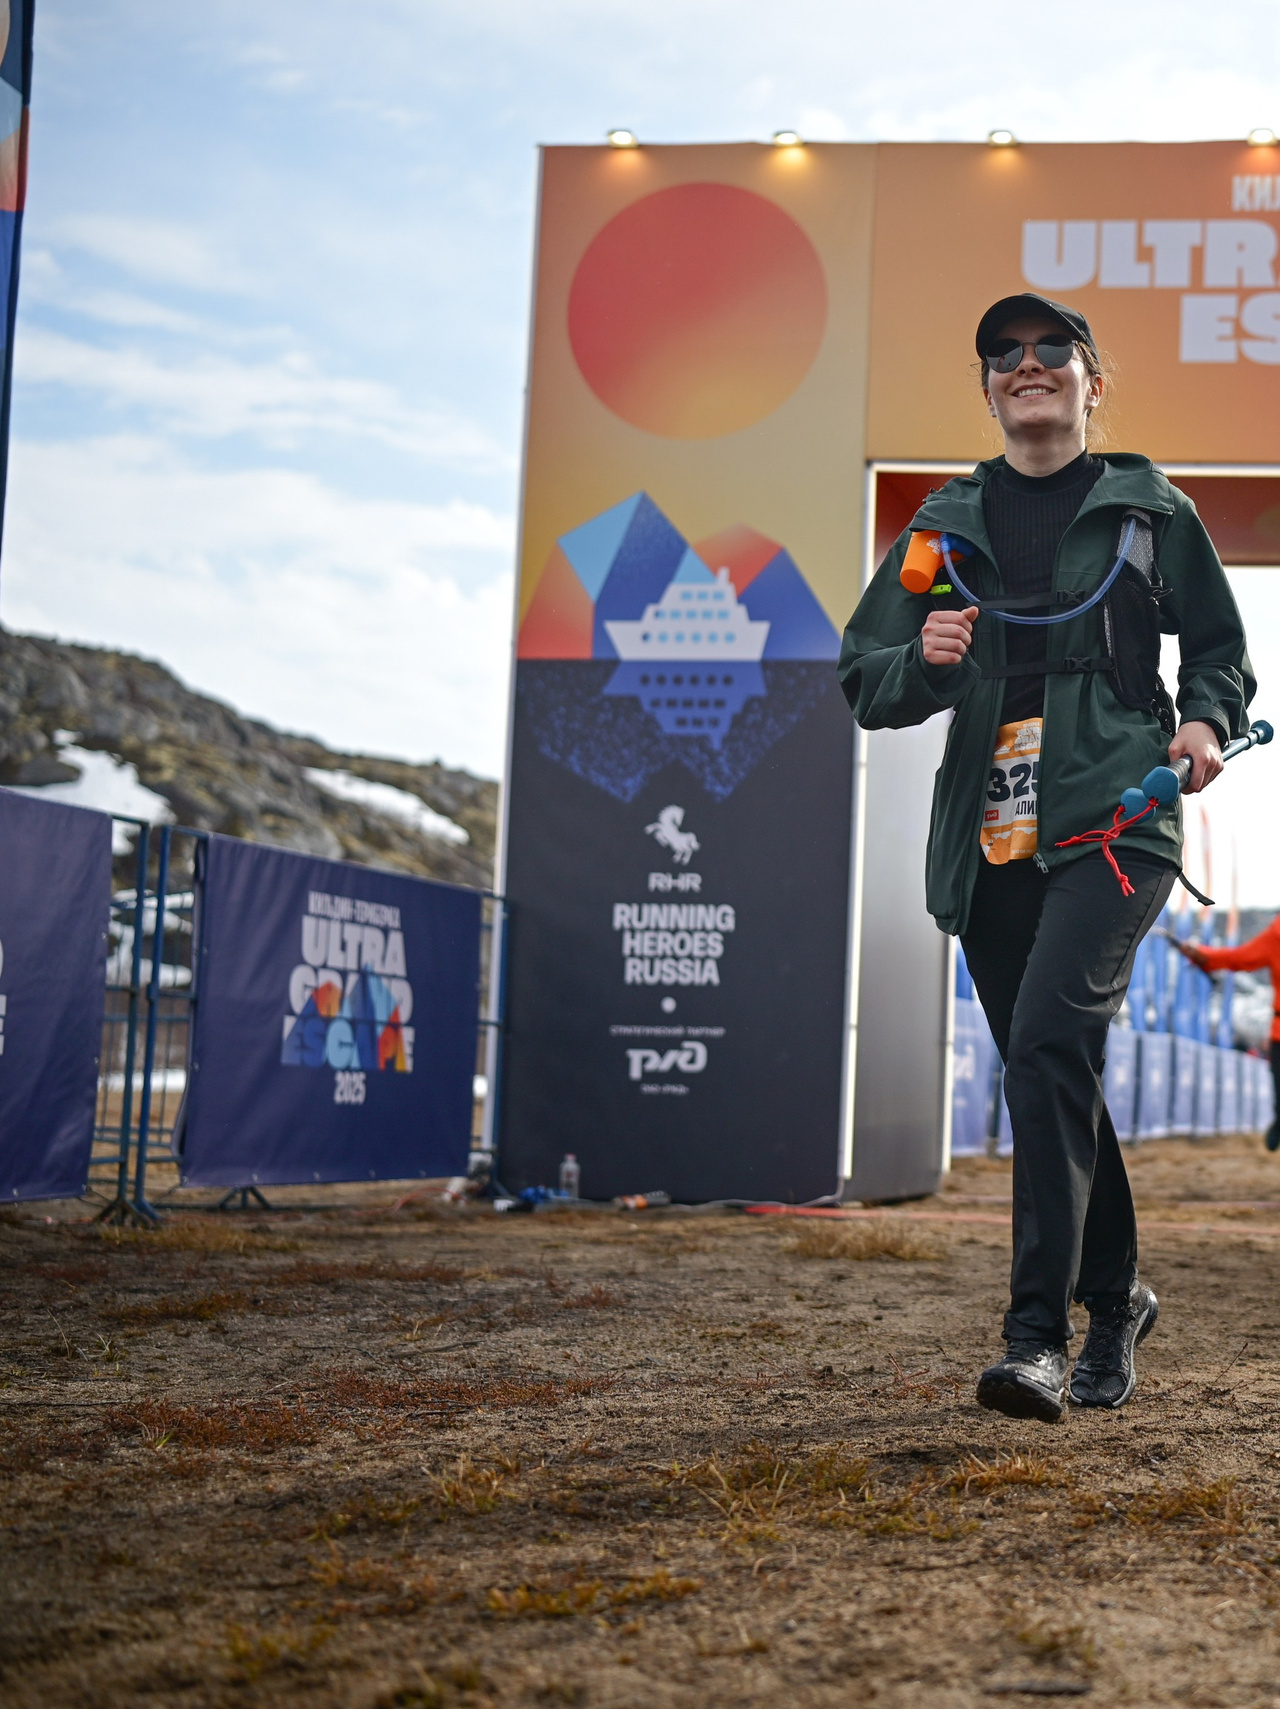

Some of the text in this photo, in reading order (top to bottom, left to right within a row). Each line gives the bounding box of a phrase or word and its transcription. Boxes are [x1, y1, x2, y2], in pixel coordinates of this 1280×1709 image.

[1014, 800, 1038, 816] АЛИ
[648, 872, 702, 892] RHR
[613, 903, 736, 932] RUNNING
[301, 914, 407, 978] ULTRA
[622, 930, 725, 958] HEROES
[624, 957, 720, 986] RUSSIA
[289, 964, 413, 1025] GRAND
[281, 1014, 415, 1074] ESCAPE
[334, 1070, 367, 1105] 2025
